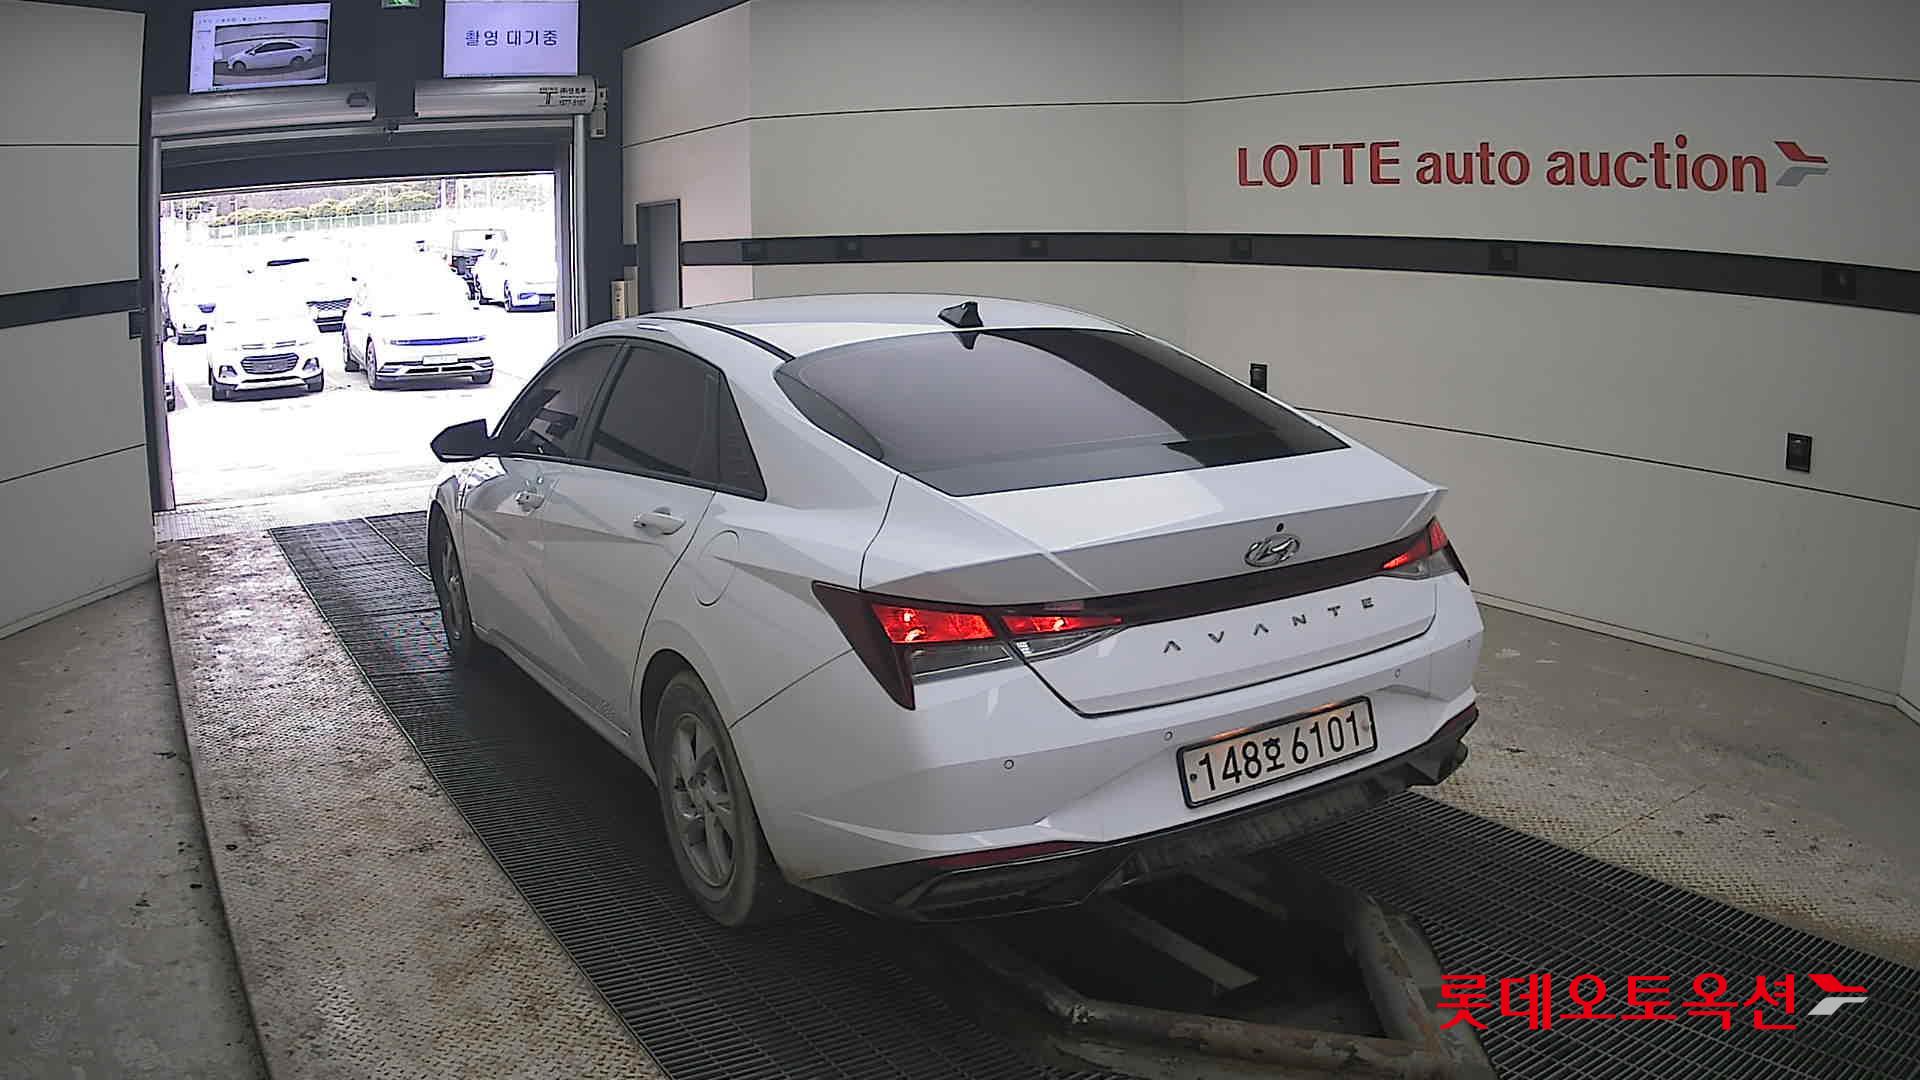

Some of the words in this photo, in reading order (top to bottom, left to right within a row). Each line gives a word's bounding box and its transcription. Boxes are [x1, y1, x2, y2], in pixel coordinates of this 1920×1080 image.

[466, 30, 498, 46] 촬영
[506, 30, 558, 46] 대기중
[1237, 143, 1399, 187] LOTTE
[1415, 142, 1531, 186] auto
[1546, 135, 1767, 193] auction
[1163, 597, 1375, 653] AVANTE
